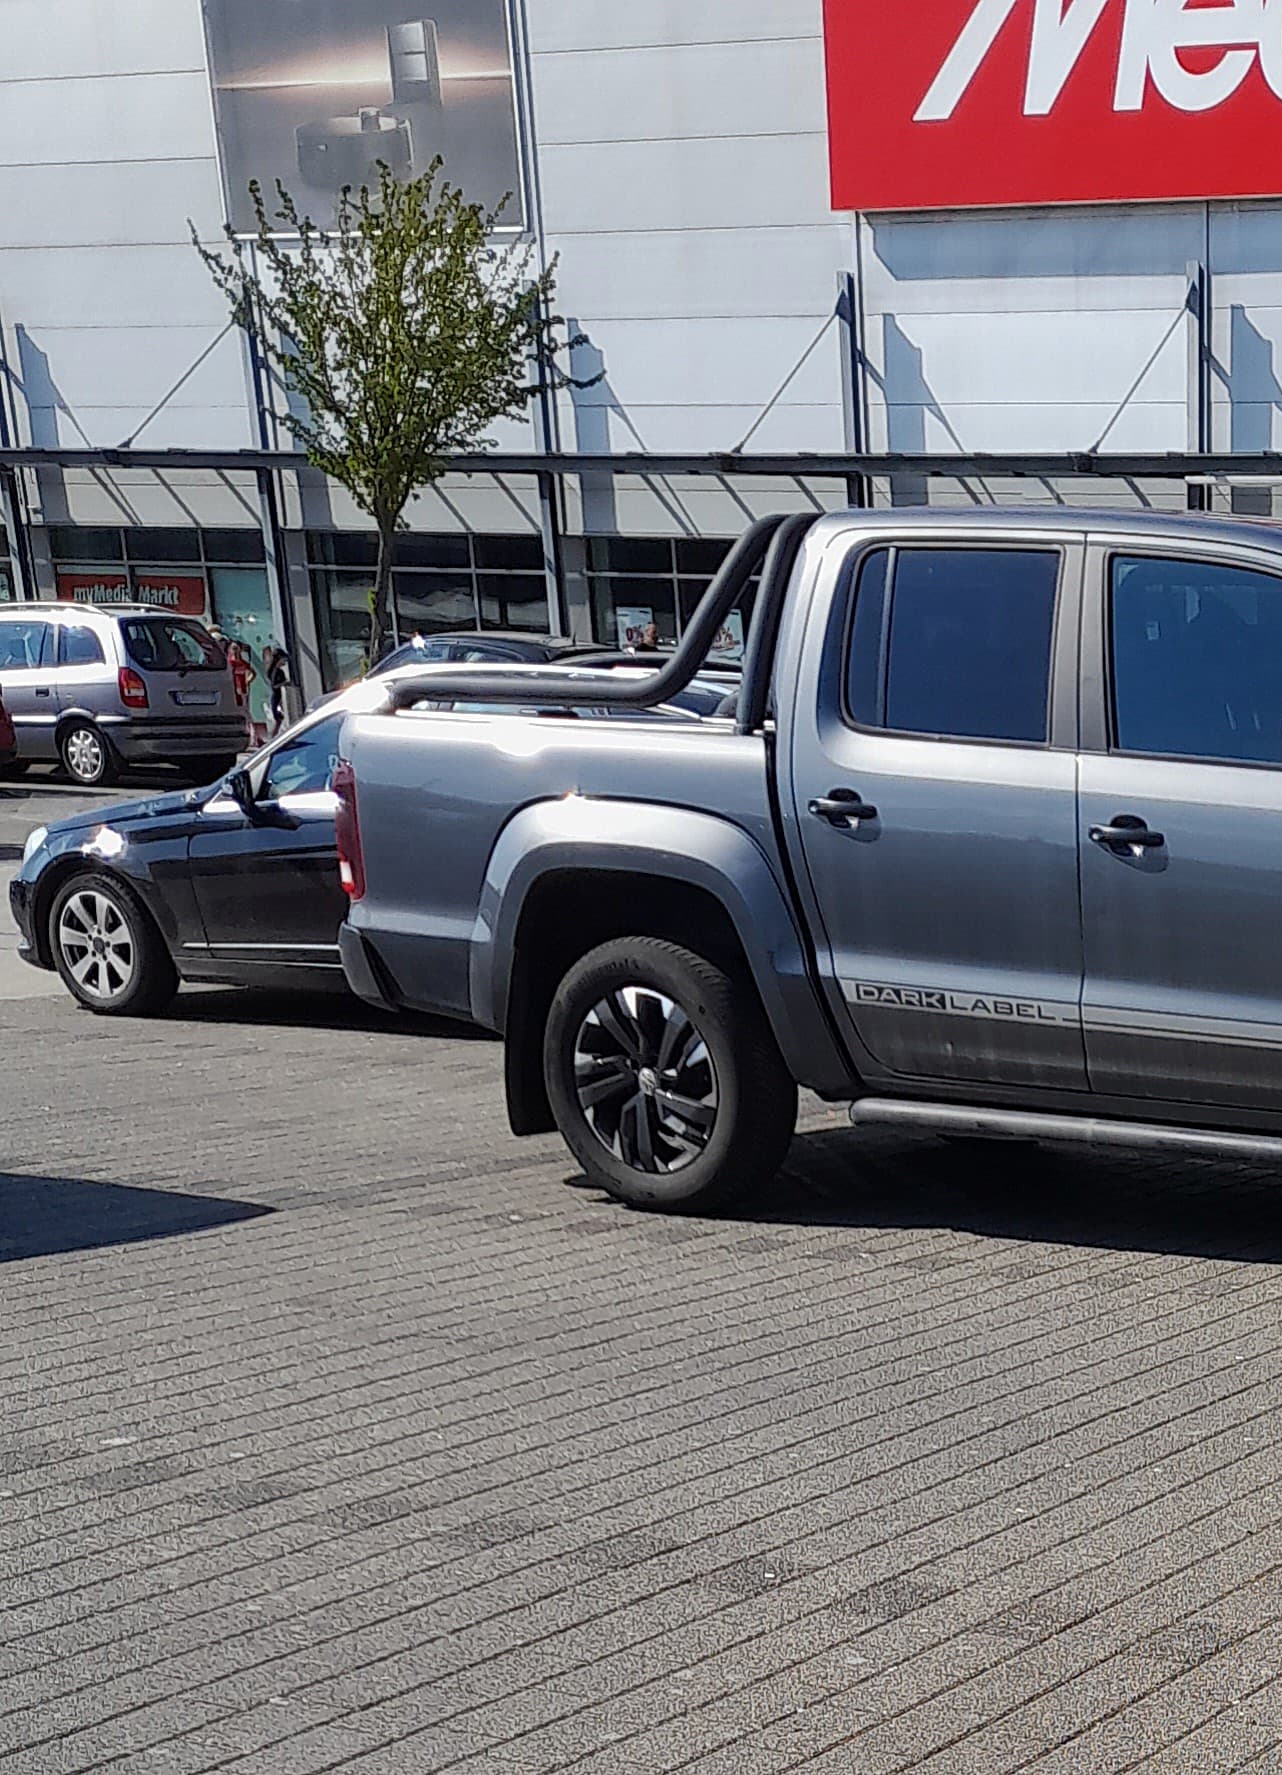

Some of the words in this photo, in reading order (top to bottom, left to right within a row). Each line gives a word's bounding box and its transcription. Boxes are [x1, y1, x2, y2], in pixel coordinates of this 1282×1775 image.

[138, 585, 180, 605] Markt
[857, 984, 945, 1010] DARK
[950, 998, 1057, 1021] LABEL
